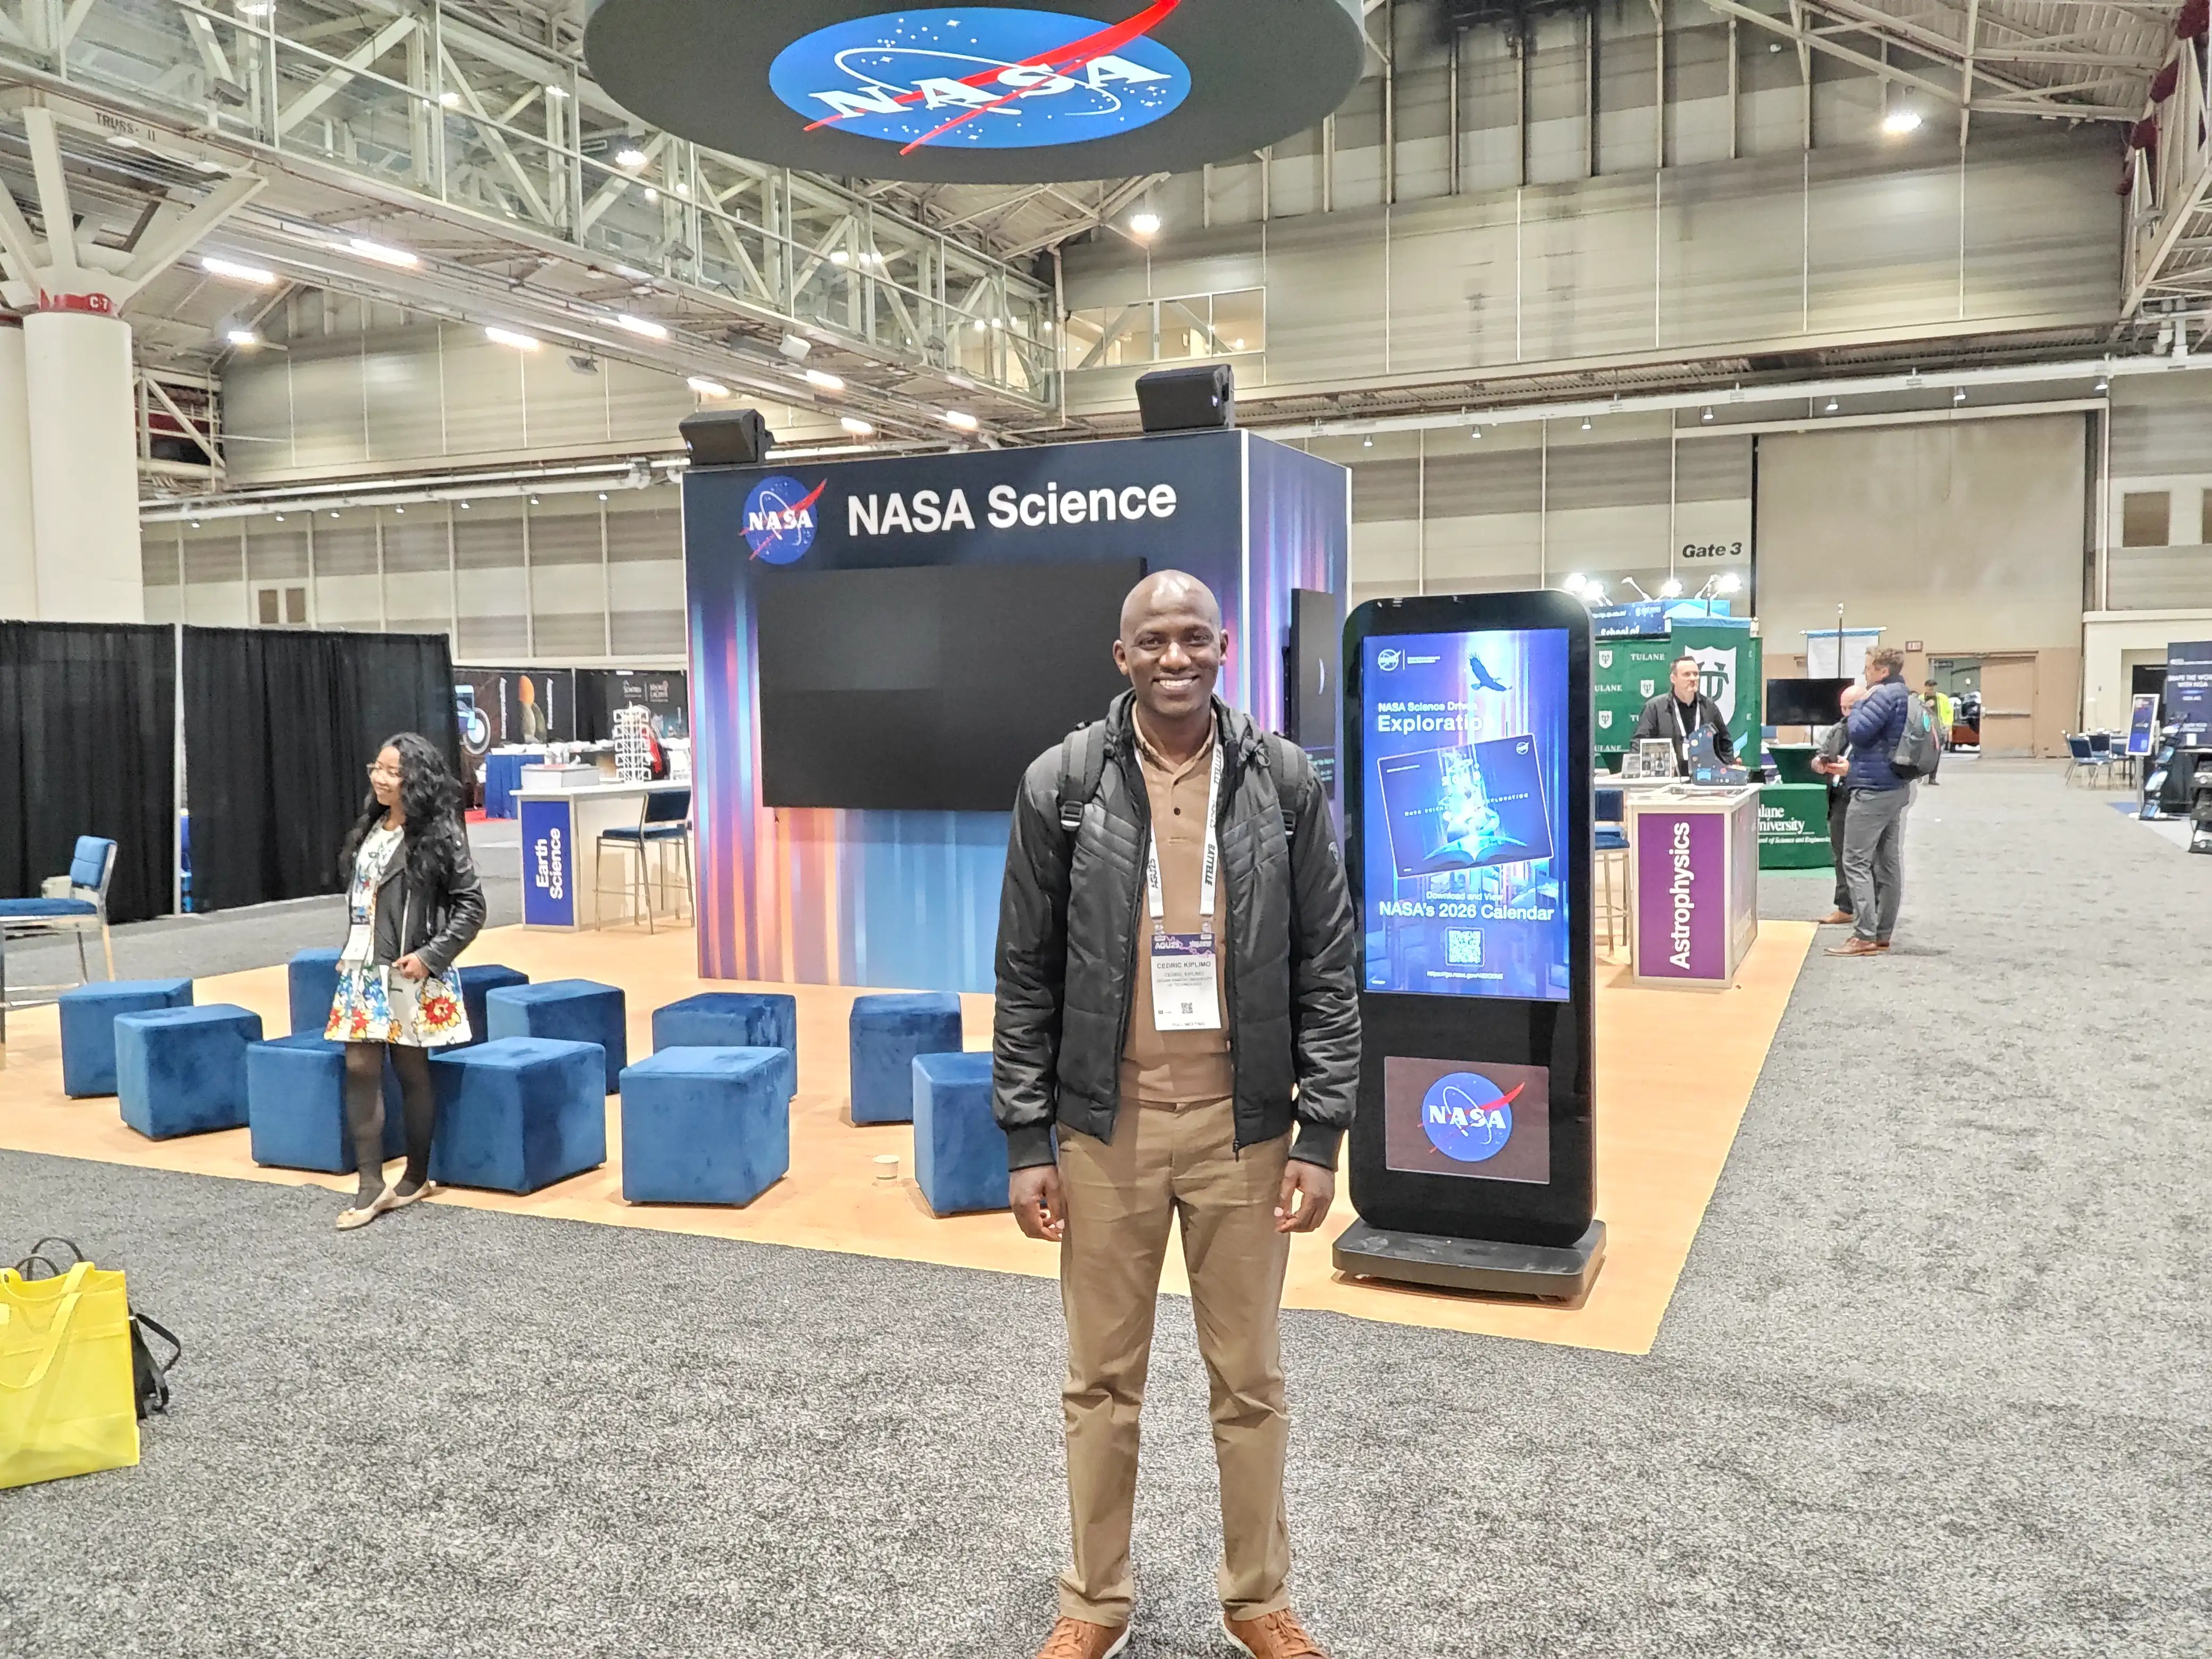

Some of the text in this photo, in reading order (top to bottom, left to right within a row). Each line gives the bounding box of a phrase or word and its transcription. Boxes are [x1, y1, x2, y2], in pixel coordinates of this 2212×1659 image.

[808, 55, 1172, 118] NASA
[749, 509, 814, 531] NASA
[848, 482, 1177, 536] NASA Science
[1682, 542, 1742, 558] Gate 3
[1595, 684, 1622, 692] ULANE
[1378, 702, 1406, 713] NASA
[1407, 702, 1445, 711] Science
[1758, 817, 1805, 834] niversity
[534, 839, 549, 887] Earth
[550, 828, 563, 900] Science
[1204, 843, 1216, 886] BATTELLE
[1426, 890, 1504, 901] Download and View
[1669, 822, 1695, 970] Astrophysics
[1379, 901, 1554, 921] NASA's 2026 Calendar
[1429, 1105, 1506, 1129] NASA
